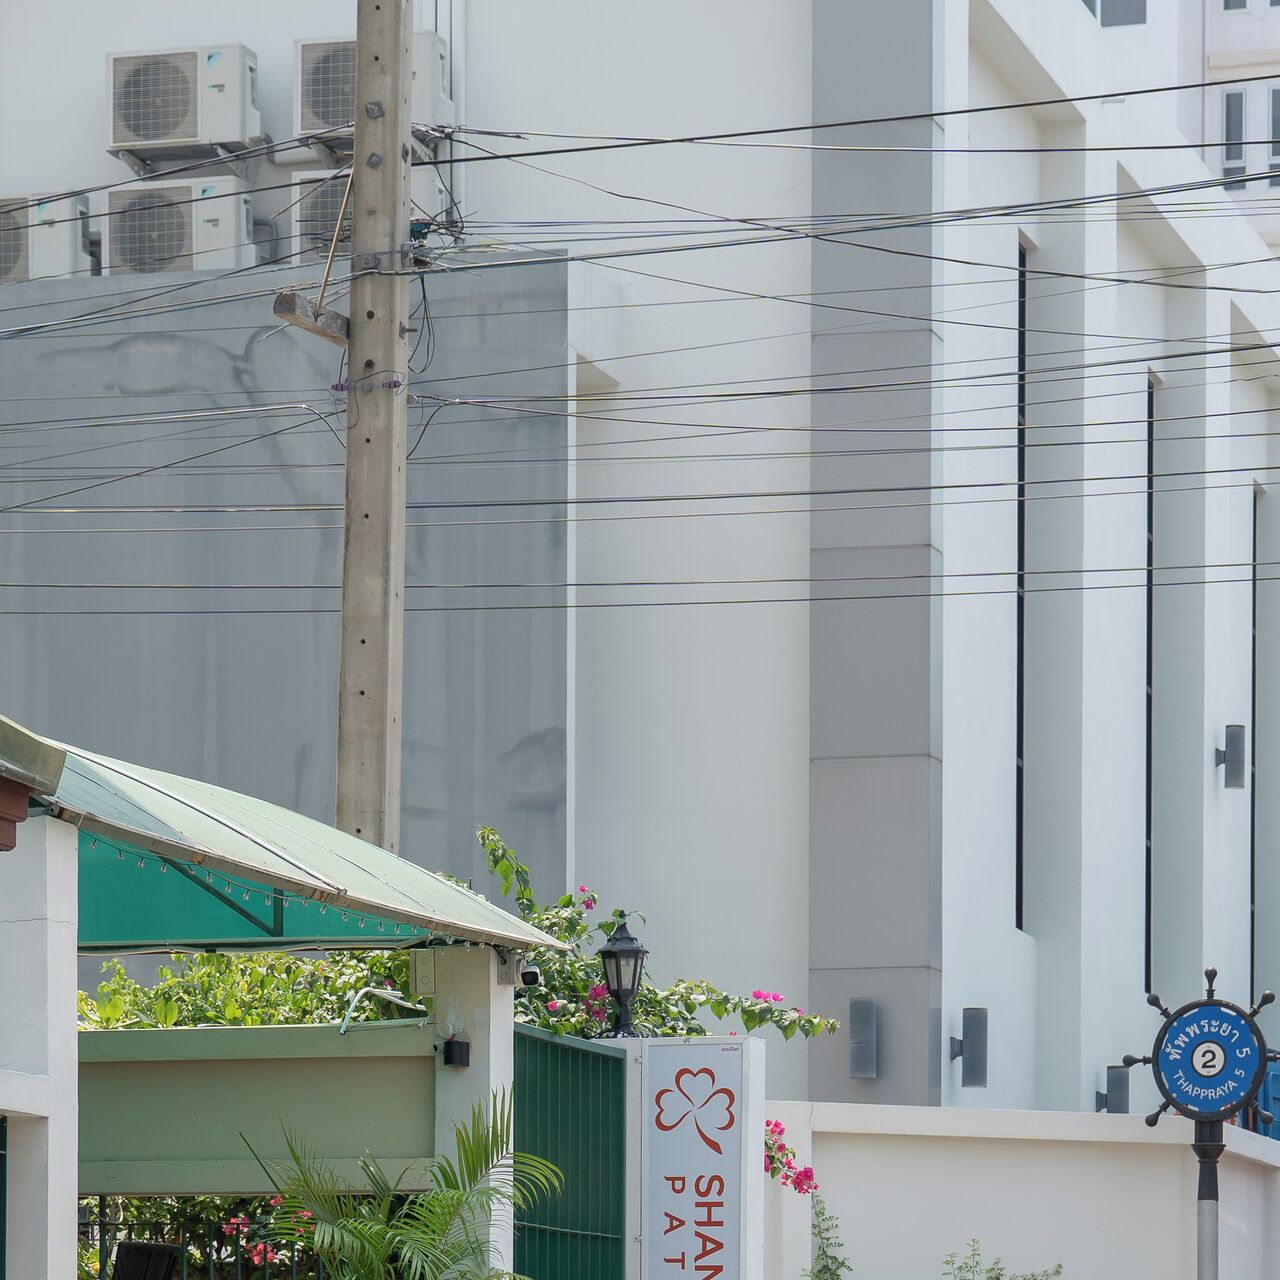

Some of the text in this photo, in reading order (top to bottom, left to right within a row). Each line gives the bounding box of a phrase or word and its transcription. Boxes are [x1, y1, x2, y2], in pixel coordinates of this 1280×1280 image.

[1165, 1019, 1251, 1061] ทัพพระยา 5
[1201, 1049, 1217, 1069] 2
[1172, 1068, 1245, 1100] THAPPRAYA 5
